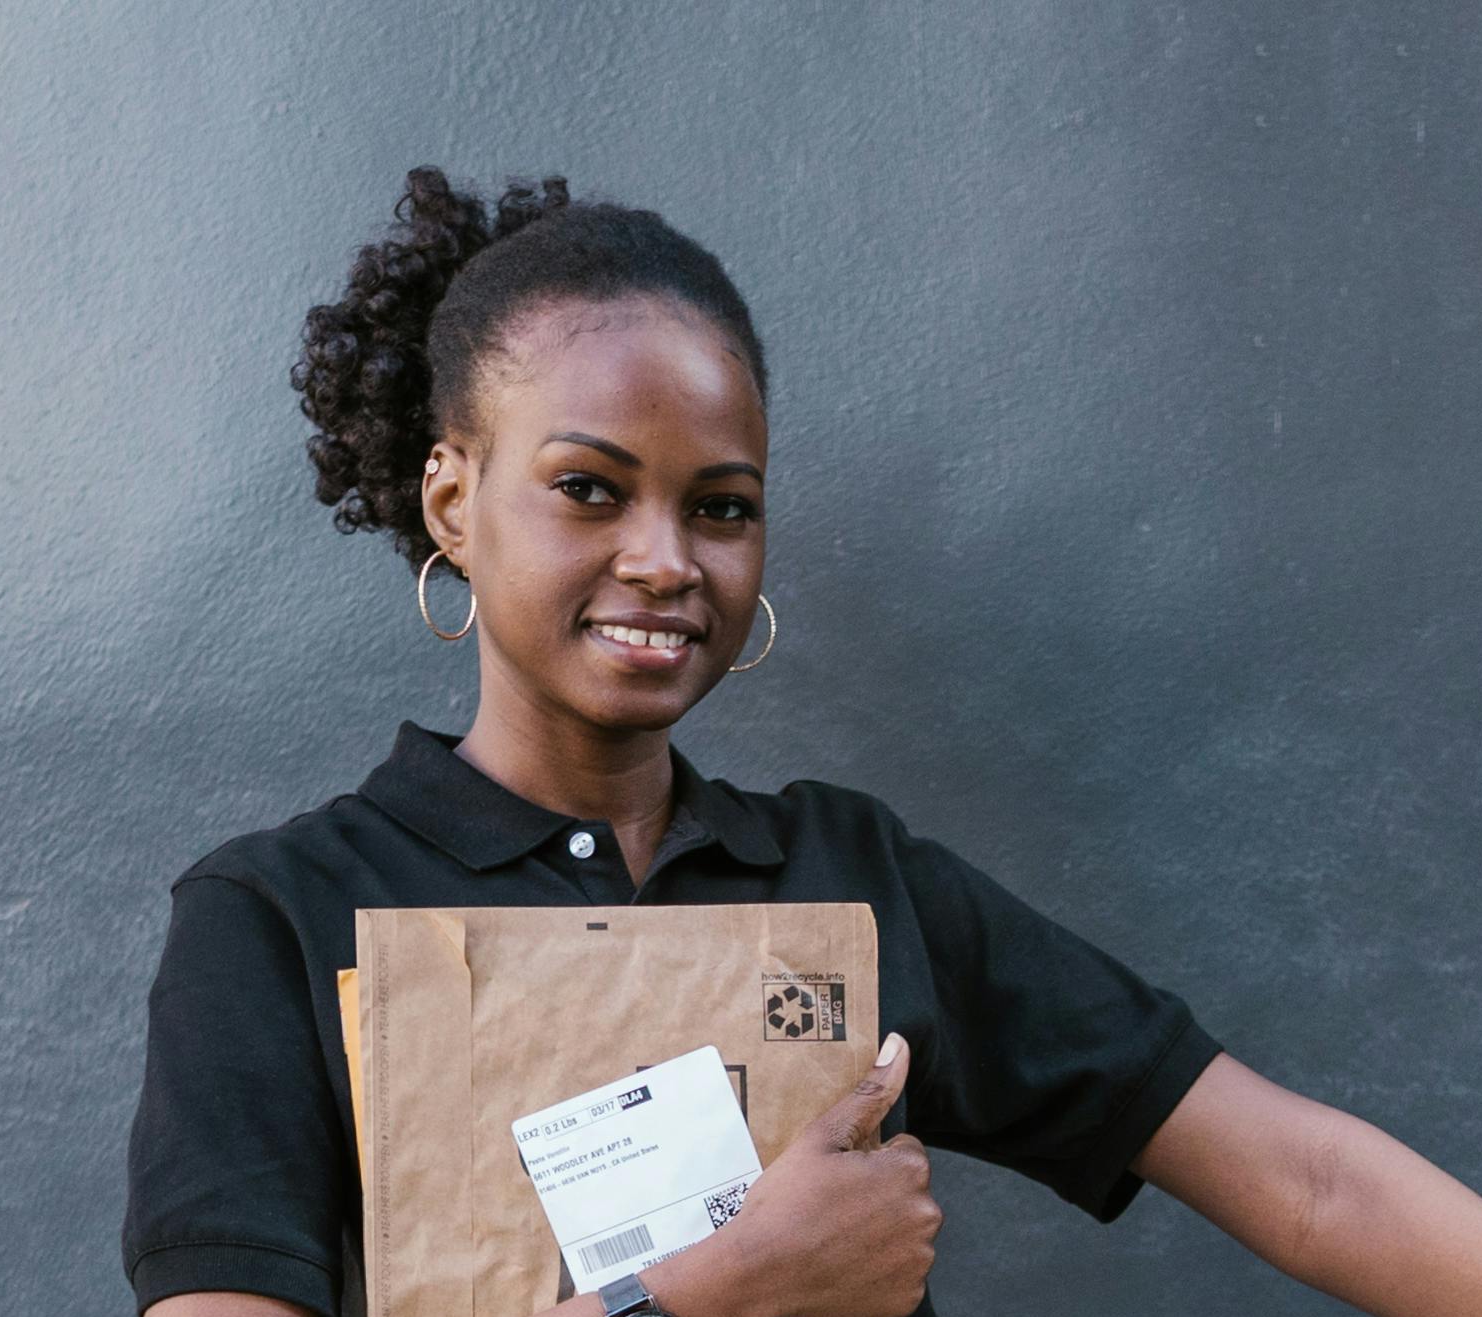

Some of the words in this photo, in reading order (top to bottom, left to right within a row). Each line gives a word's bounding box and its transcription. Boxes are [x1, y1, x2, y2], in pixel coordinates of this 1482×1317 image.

[761, 971, 845, 983] how2recycle.info
[820, 993, 830, 1030] PAPER
[833, 1000, 843, 1024] BAG
[517, 1127, 540, 1143] LEX2
[561, 1117, 578, 1131] Lbs
[591, 1101, 616, 1117] 03/17
[553, 1154, 589, 1175] WOODLEY
[590, 1147, 606, 1159] AVE
[607, 1141, 621, 1153] APT
